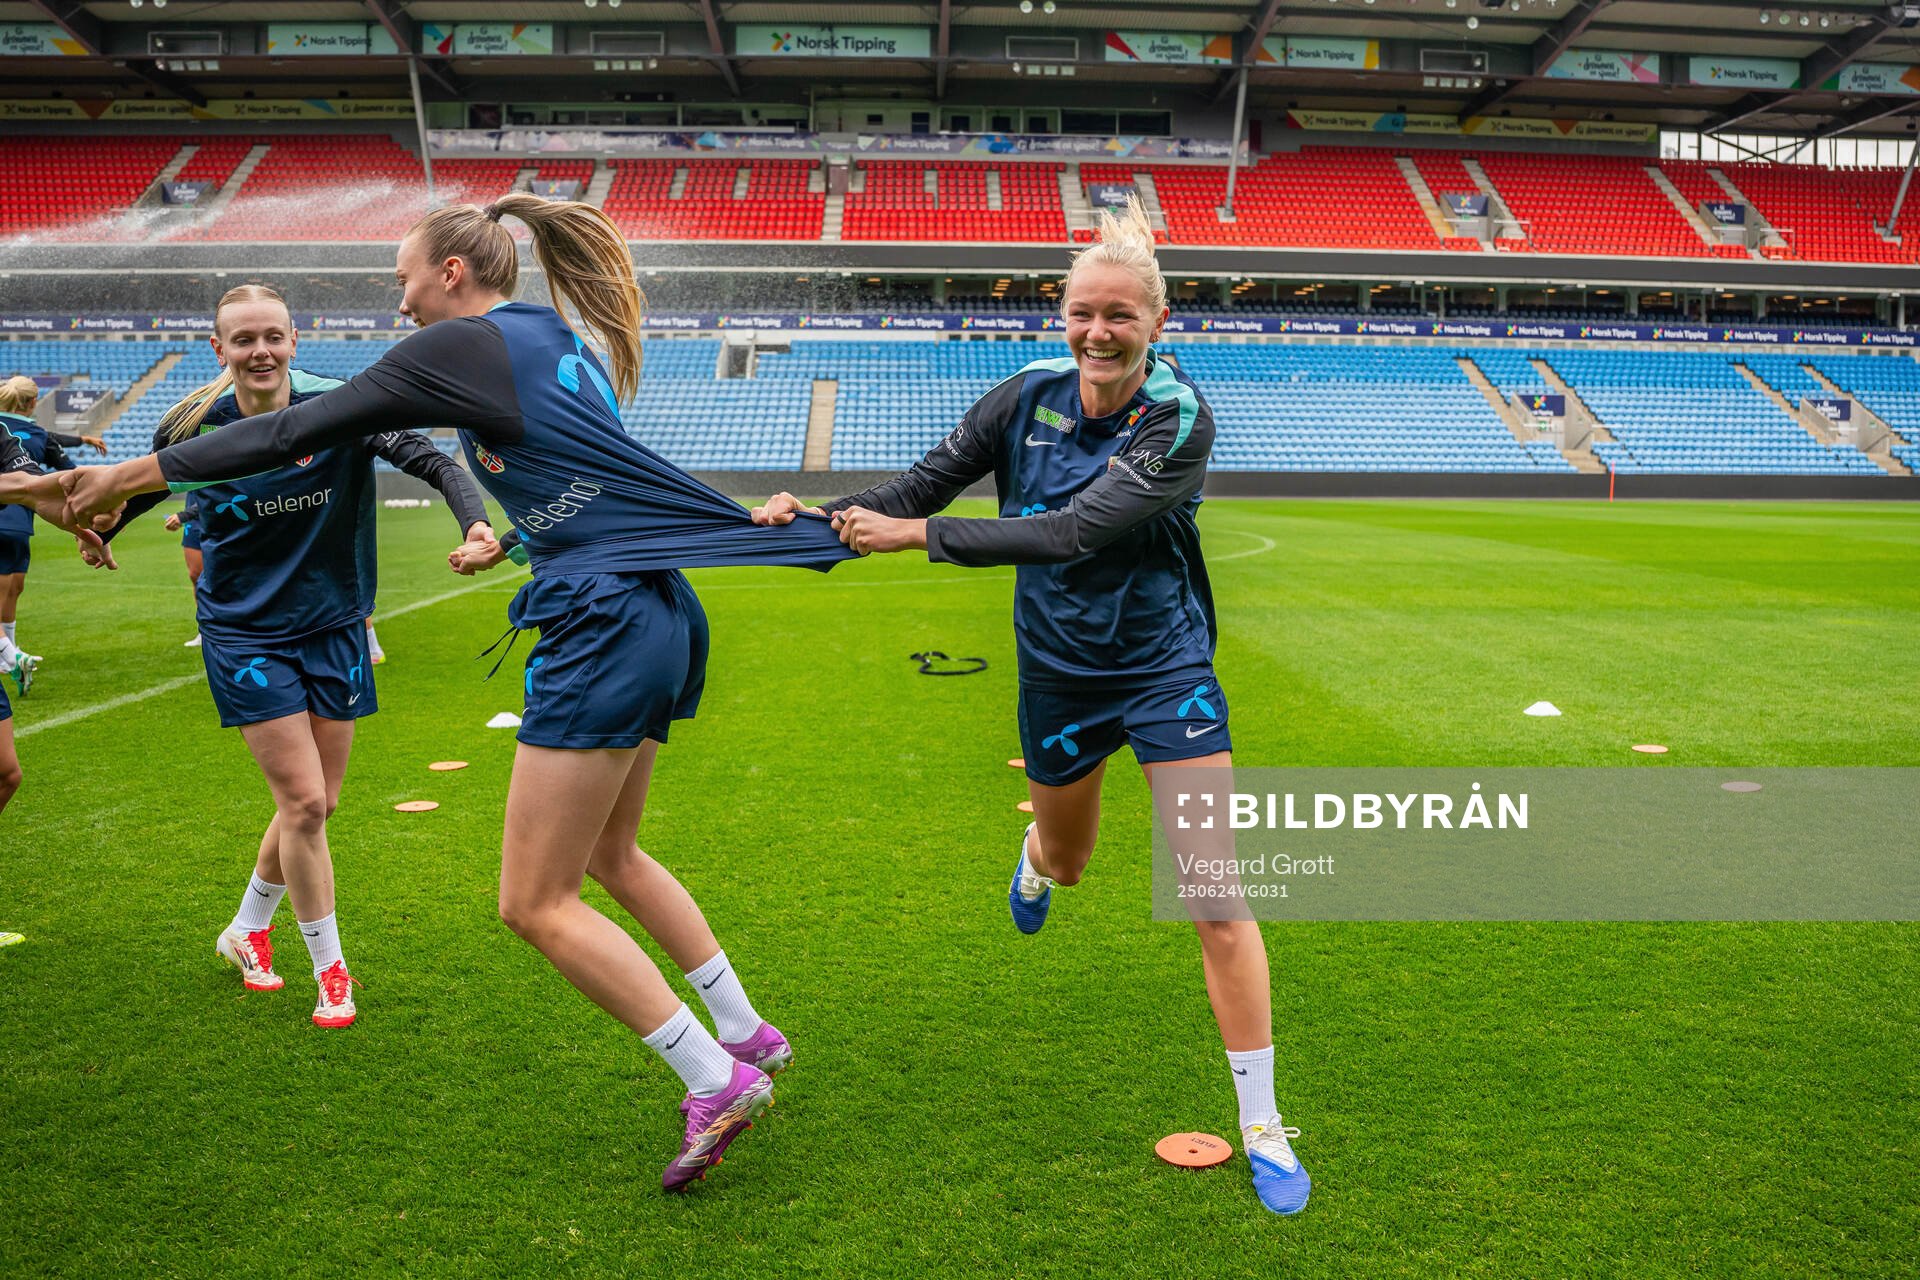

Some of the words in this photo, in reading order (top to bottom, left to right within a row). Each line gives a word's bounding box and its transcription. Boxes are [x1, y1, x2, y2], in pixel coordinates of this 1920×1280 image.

[310, 36, 336, 44] Norsk
[337, 35, 372, 47] Tipping
[797, 36, 839, 49] Norsk
[842, 36, 896, 54] Tipping
[1296, 50, 1320, 58] Norsk
[1321, 50, 1354, 61] Tipping
[1724, 70, 1748, 78] Norsk
[1749, 70, 1777, 81] Tipping
[18, 104, 41, 113] Norsk
[43, 104, 72, 115] Tipping
[248, 105, 270, 113] Norsk
[273, 105, 301, 115] Tipping
[1526, 124, 1552, 134] Tipping
[749, 138, 772, 146] Norsk
[774, 138, 805, 148] Tipping
[894, 140, 918, 148] Norsk
[919, 140, 950, 151] Tipping
[3, 320, 24, 328] Norsk
[25, 319, 53, 329] Tipping
[83, 319, 105, 328] Norsk
[106, 318, 134, 329] Tipping
[164, 319, 185, 328] Norsk
[186, 318, 214, 329] Tipping
[325, 319, 346, 327] Norsk
[346, 319, 375, 329] Tipping
[649, 318, 670, 327] Norsk
[671, 318, 700, 329] Tipping
[730, 318, 751, 327] Norsk
[752, 318, 781, 329] Tipping
[812, 318, 833, 327] Norsk
[834, 318, 862, 329] Tipping
[893, 318, 915, 327] Norsk
[915, 318, 944, 329] Tipping
[974, 319, 995, 328] Norsk
[996, 319, 1025, 329] Tipping
[1214, 320, 1234, 329] Norsk
[1235, 320, 1263, 331] Tipping
[1292, 321, 1312, 330] Norsk
[1313, 321, 1340, 332] Tipping
[1369, 323, 1390, 332] Norsk
[1390, 324, 1416, 334] Tipping
[1444, 324, 1464, 333] Norsk
[1465, 325, 1490, 335] Tipping
[1519, 326, 1538, 335] Norsk
[1539, 327, 1564, 337] Tipping
[1592, 328, 1611, 337] Norsk
[1612, 328, 1637, 339] Tipping
[1664, 329, 1683, 338] Norsk
[1684, 330, 1708, 340] Tipping
[1735, 331, 1753, 339] Norsk
[1754, 331, 1778, 341] Tipping
[1804, 332, 1822, 341] Norsk
[1823, 333, 1847, 343] Tipping
[1872, 334, 1890, 342] Norsk
[1891, 334, 1914, 345] Tipping
[1034, 405, 1064, 430] KIWI
[254, 487, 332, 517] telenor
